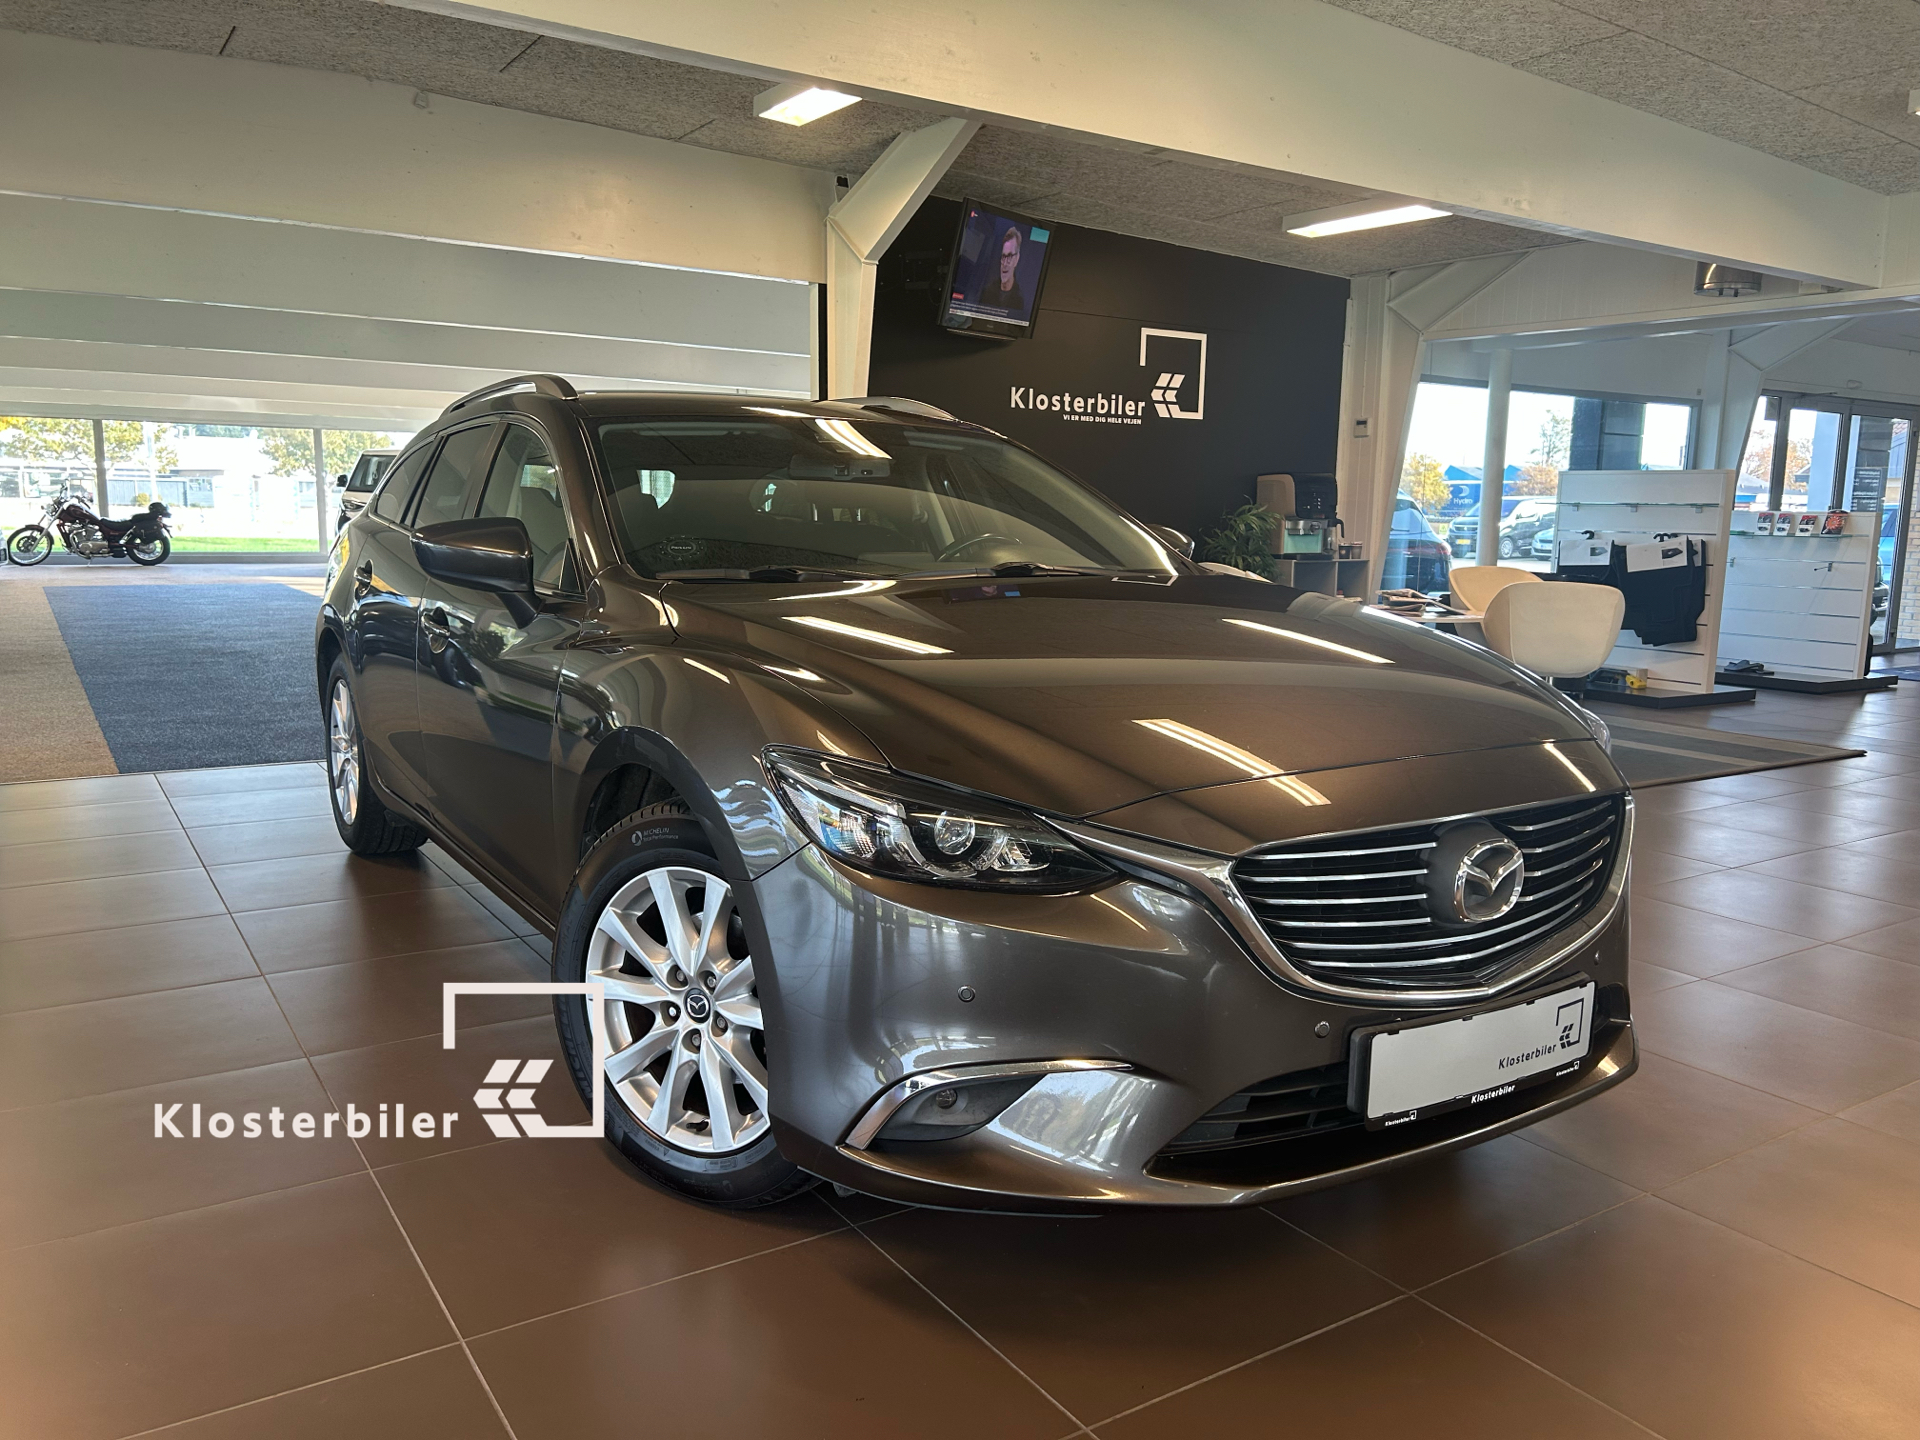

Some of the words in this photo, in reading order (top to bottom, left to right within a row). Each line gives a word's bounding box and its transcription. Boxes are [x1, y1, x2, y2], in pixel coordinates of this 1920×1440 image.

[1010, 386, 1146, 416] Klosterbiler
[1498, 1044, 1557, 1070] Klosterbiler
[1471, 1084, 1516, 1104] Klosterbiler
